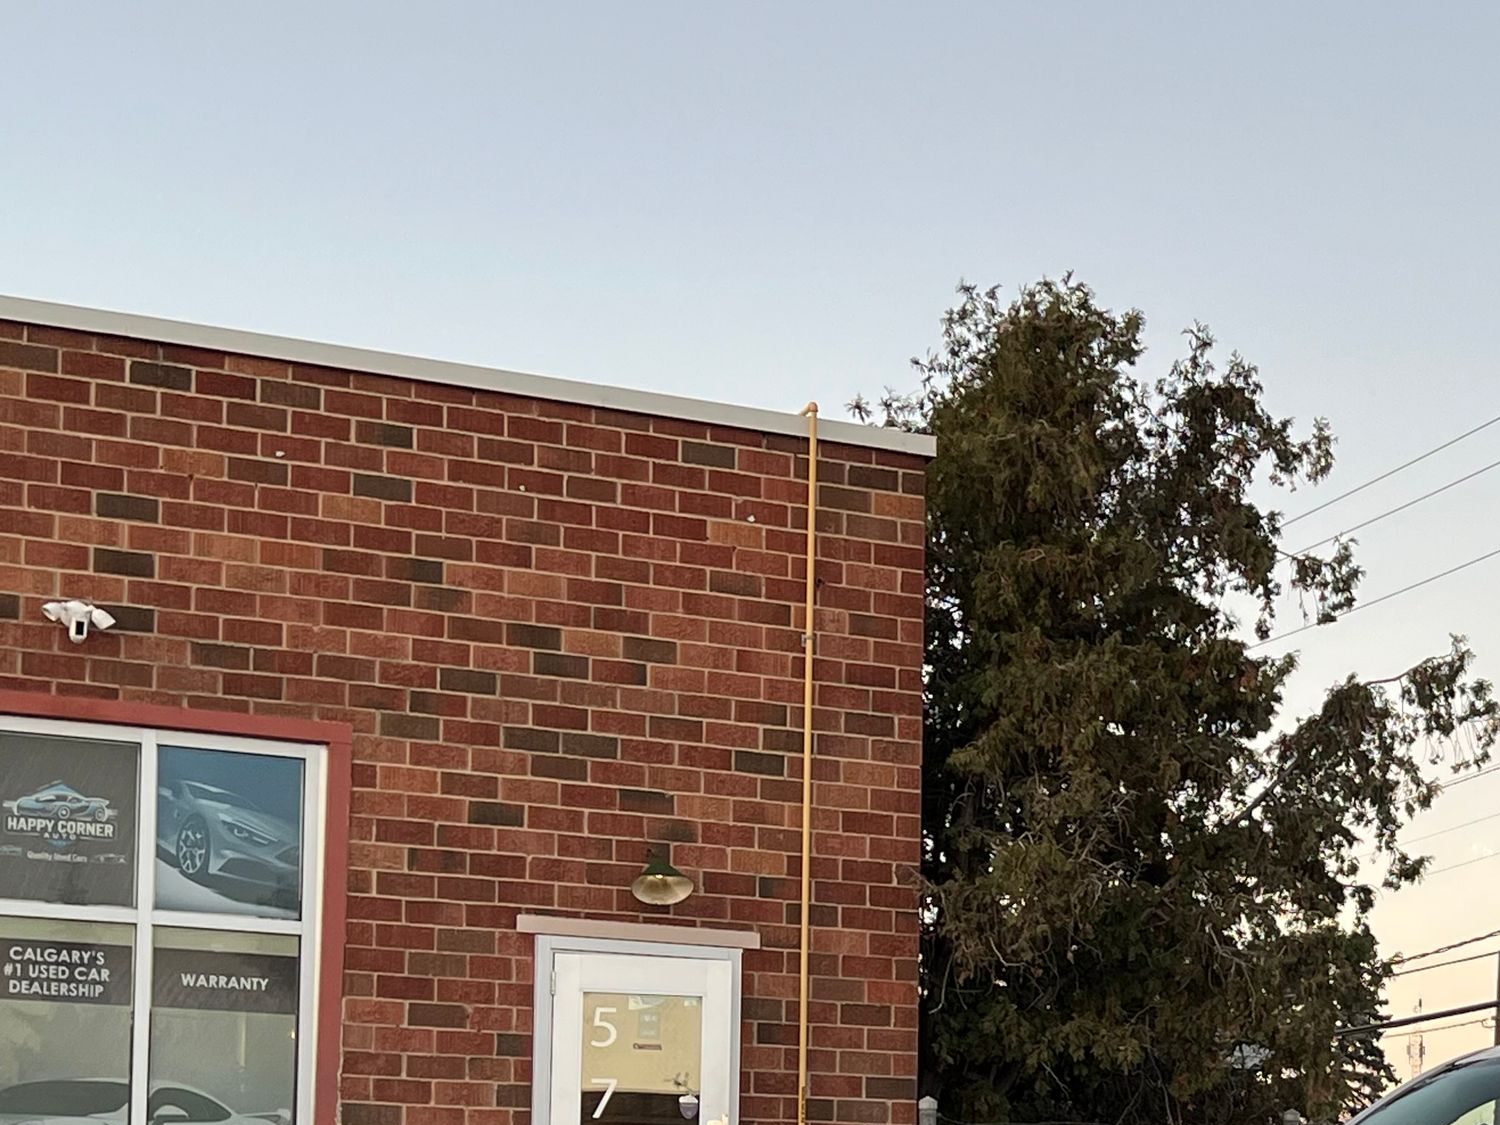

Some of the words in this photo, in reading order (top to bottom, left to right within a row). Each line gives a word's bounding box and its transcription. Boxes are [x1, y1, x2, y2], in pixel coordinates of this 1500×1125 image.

[7, 816, 54, 832] HAPPY
[57, 820, 114, 837] CORNER
[43, 832, 76, 840] AUTO
[9, 946, 105, 965] CALGARY'S
[4, 962, 21, 977] #1
[28, 963, 70, 979] USED
[74, 966, 110, 982] CAR
[8, 979, 104, 997] DEALERSHIP
[181, 973, 269, 991] WARRANTY
